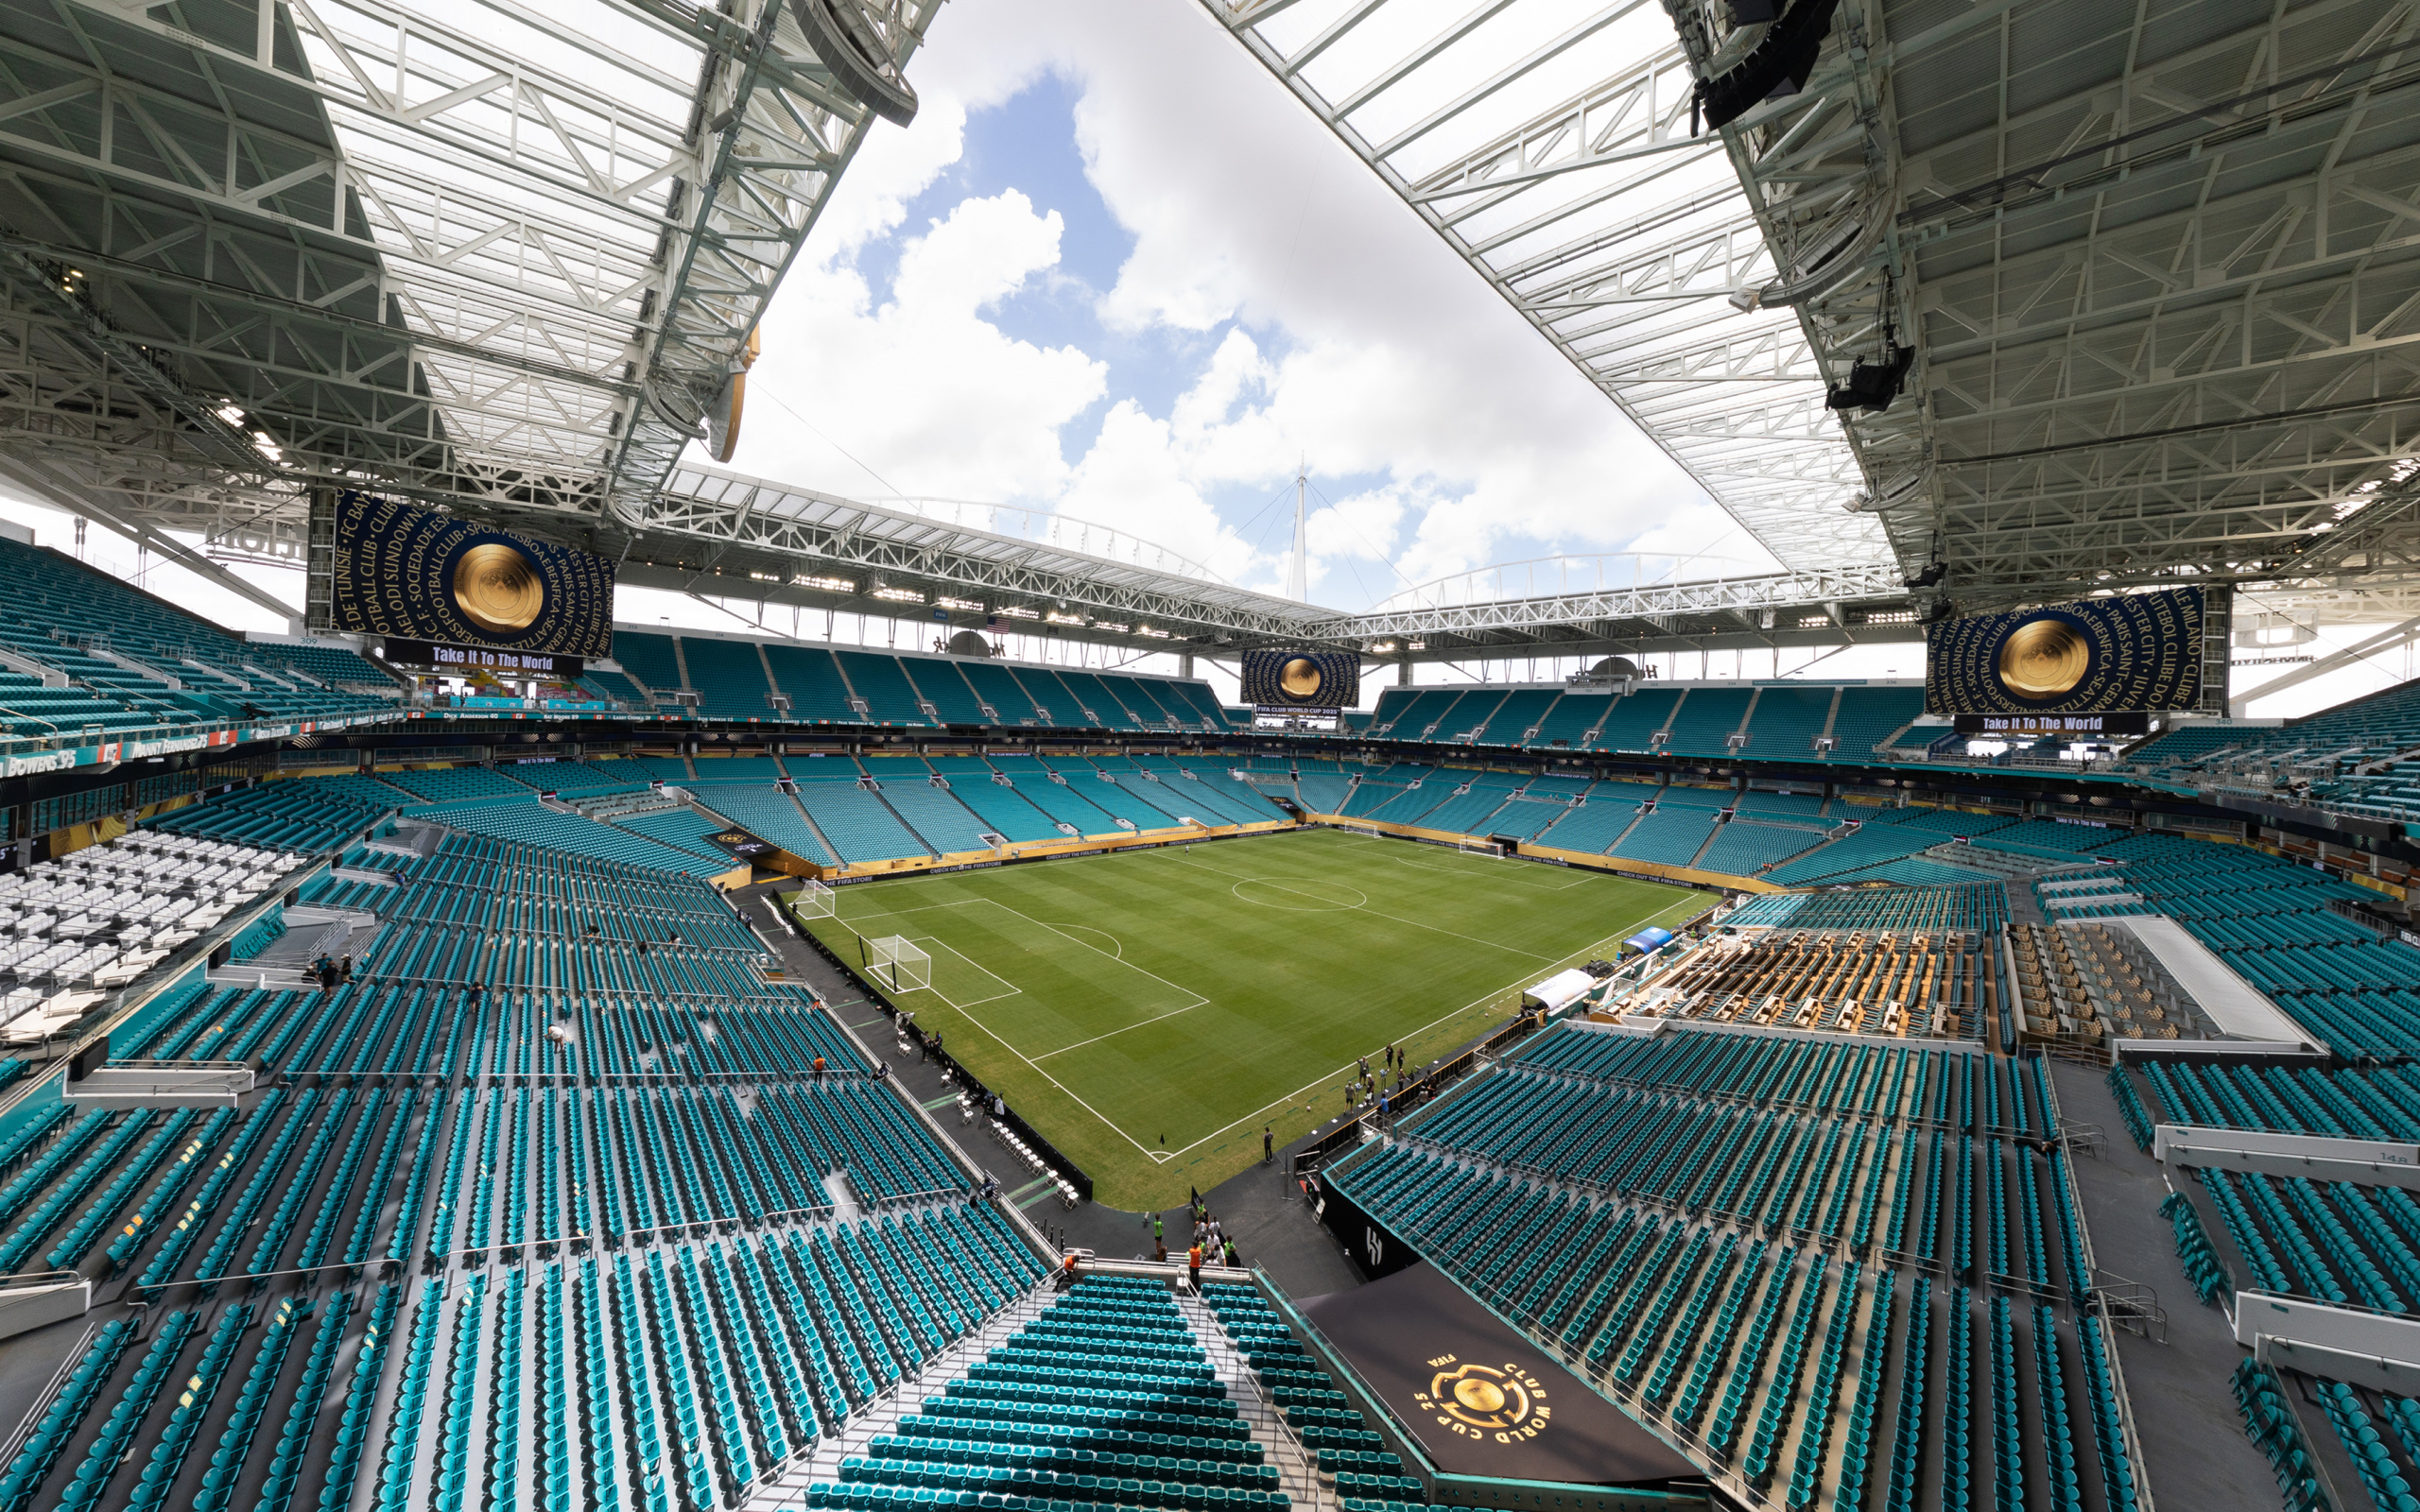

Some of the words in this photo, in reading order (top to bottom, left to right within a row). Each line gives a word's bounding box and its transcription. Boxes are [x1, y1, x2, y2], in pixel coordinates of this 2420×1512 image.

[347, 490, 372, 520] BAY
[370, 501, 398, 533] CLUB
[340, 518, 359, 538] FC
[436, 529, 464, 558] CLUB
[336, 545, 354, 601] TUNISIE
[360, 540, 377, 577] CLUB
[407, 526, 436, 602] SOCIEDADE
[428, 557, 456, 626] FOOTBALL
[545, 564, 562, 614] BENFICA
[579, 591, 589, 618] CITY
[361, 578, 396, 636] OTBALL
[542, 592, 576, 653] SAINT-GERM
[591, 601, 602, 634] CLUBE
[2144, 591, 2177, 642] FUTEBOL
[1986, 622, 2008, 648] CLUB
[2106, 609, 2132, 641] PARIS
[2181, 605, 2202, 656] MILANO
[433, 646, 464, 662] Take
[468, 649, 478, 664] It
[480, 651, 495, 666] To
[498, 653, 519, 668] The
[521, 655, 553, 671] World
[1966, 628, 1985, 687] SOCIEDADE
[2091, 622, 2113, 670] BENFICA
[2141, 635, 2155, 666] CITY
[1939, 651, 1949, 677] CLUB
[1980, 648, 2000, 701] FOOTBALL
[2089, 641, 2134, 713] SAINT-GERM
[2158, 644, 2178, 682] CLUBE
[2149, 683, 2169, 703] DO
[2172, 664, 2199, 704] CLUBE
[1983, 717, 2009, 730] Take
[2012, 717, 2020, 730] It
[2023, 717, 2036, 730] To
[2039, 716, 2061, 730] The
[2065, 716, 2103, 730] World
[8, 755, 58, 777] BOWENS
[59, 750, 77, 769] 95
[132, 741, 162, 758] MANNY
[1674, 880, 1693, 888] STORE
[1427, 1353, 1457, 1367] FIFA
[1504, 1363, 1547, 1399] CLUB
[1414, 1392, 1436, 1411] 25
[1437, 1416, 1483, 1440] CUP
[1495, 1406, 1551, 1444] WORLD
